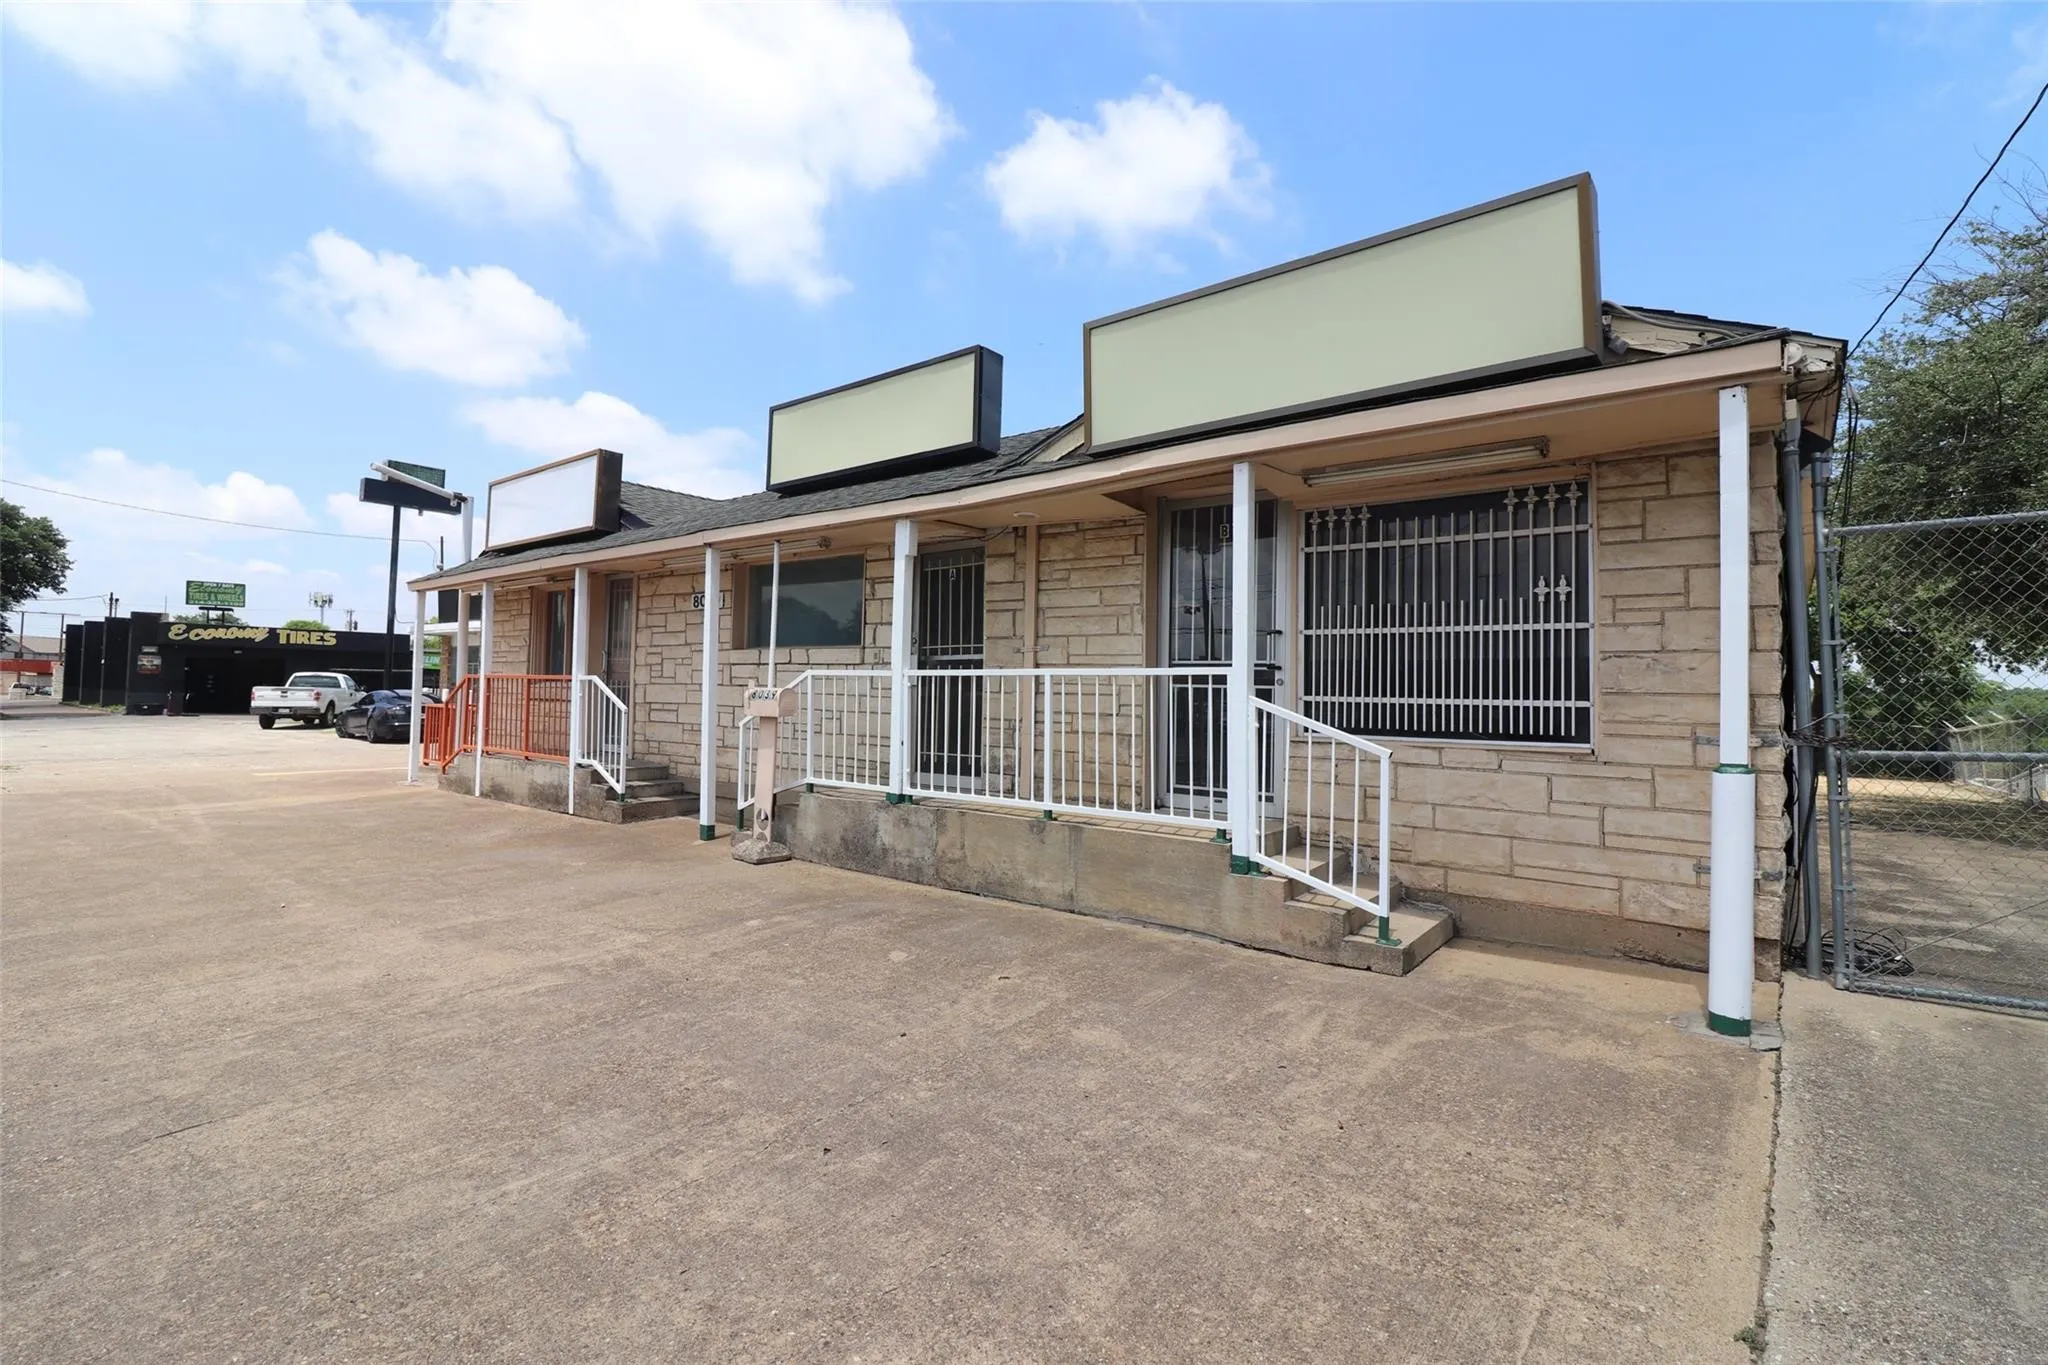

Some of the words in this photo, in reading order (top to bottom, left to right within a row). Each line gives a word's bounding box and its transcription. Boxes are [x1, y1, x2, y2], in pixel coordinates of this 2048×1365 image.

[189, 592, 209, 600] TIRES
[168, 624, 270, 642] Economy
[277, 629, 337, 645] TIRES
